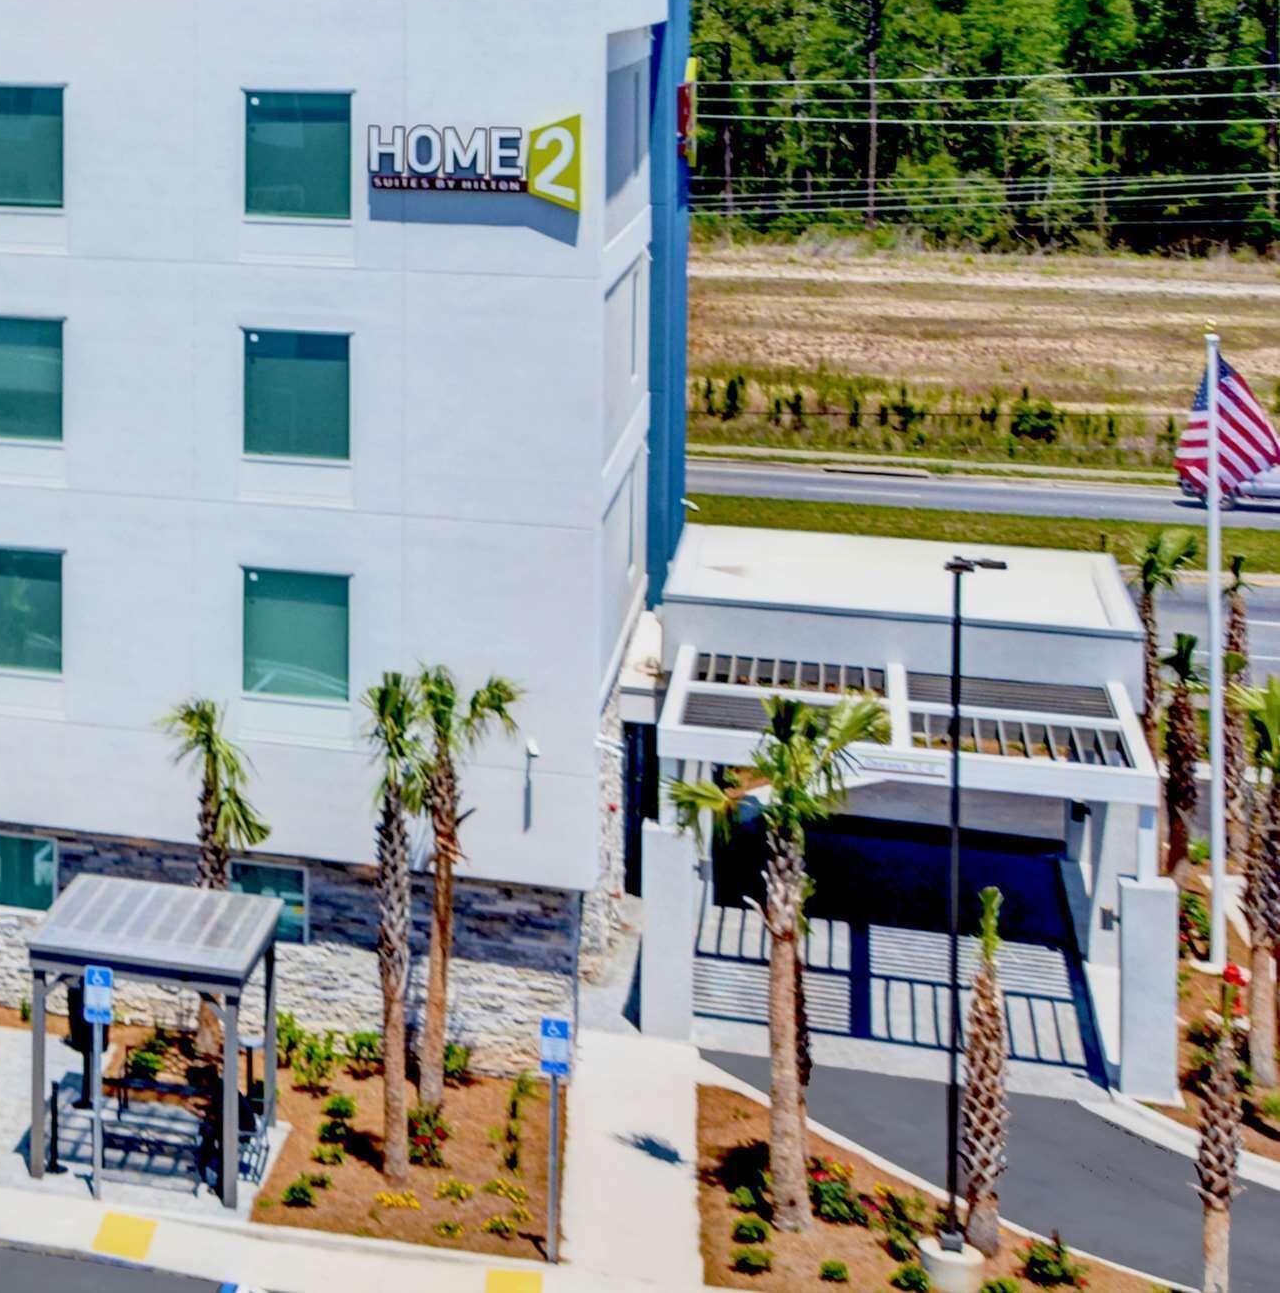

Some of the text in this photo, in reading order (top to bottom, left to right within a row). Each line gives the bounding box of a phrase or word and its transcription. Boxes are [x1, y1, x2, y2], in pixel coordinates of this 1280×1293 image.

[372, 177, 521, 191] SUITES BY HILTON
